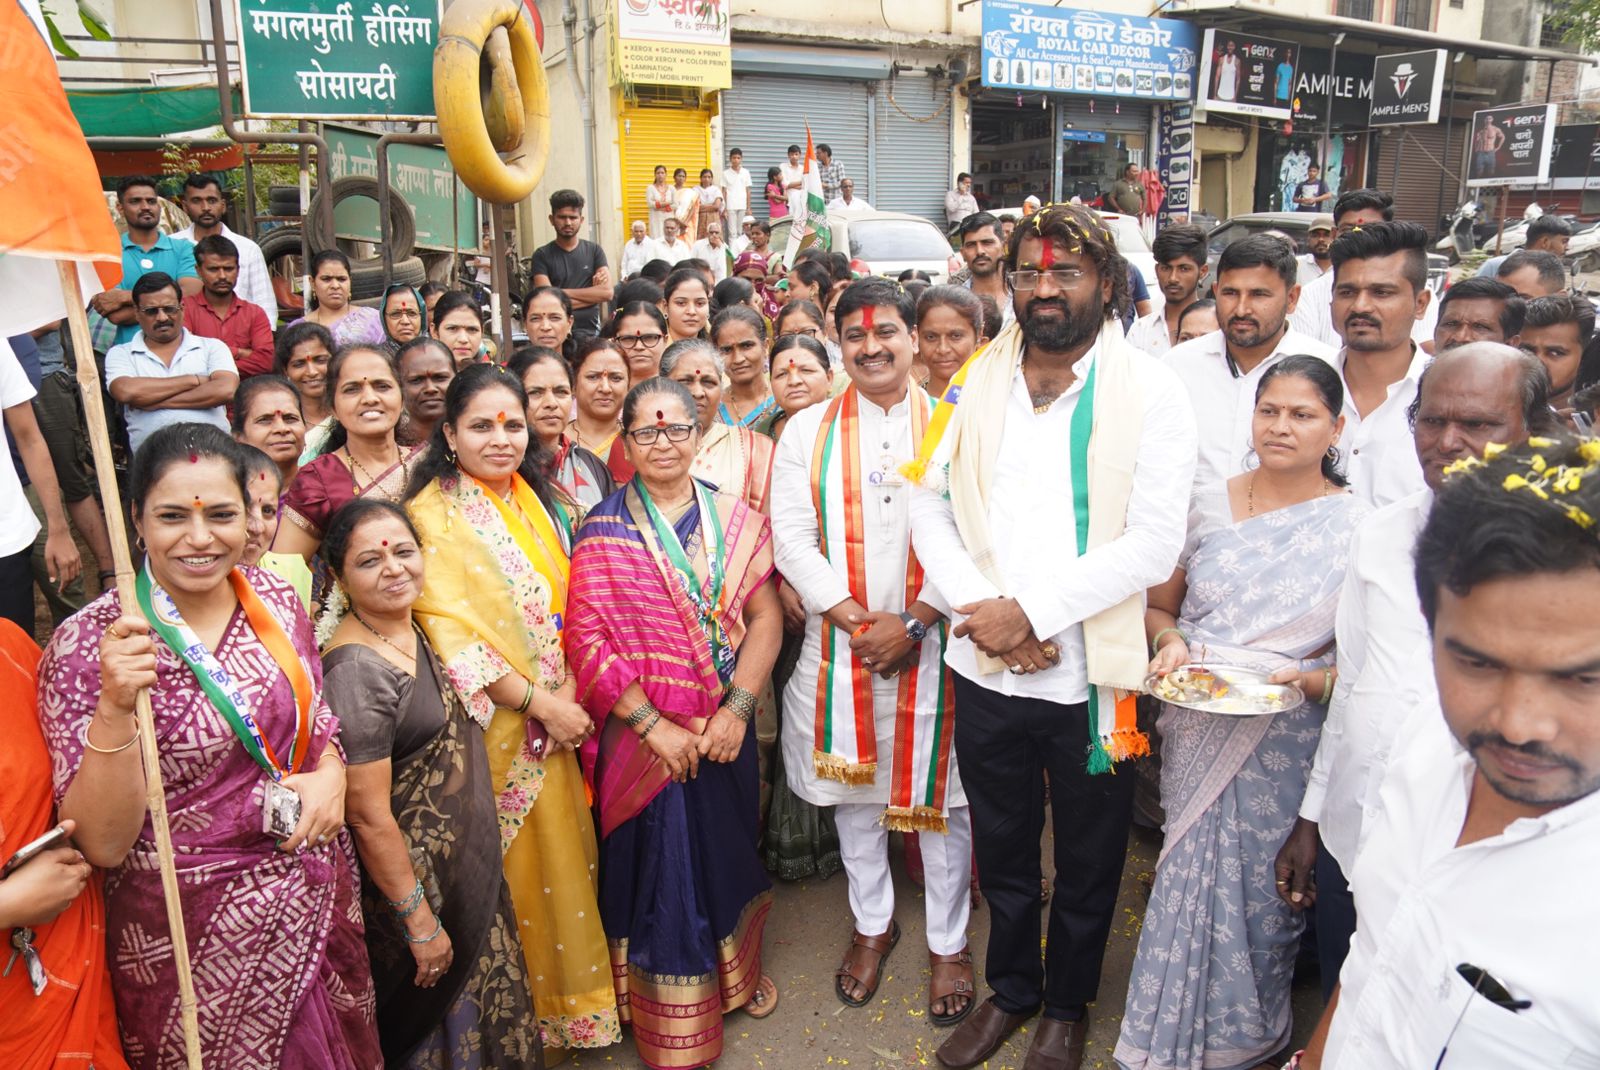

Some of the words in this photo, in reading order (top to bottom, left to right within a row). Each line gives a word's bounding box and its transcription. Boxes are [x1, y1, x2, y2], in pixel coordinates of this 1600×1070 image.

[362, 3, 432, 47] हौसिंग
[1009, 8, 1069, 38] रॉयल
[1073, 18, 1116, 43] कार
[1119, 18, 1172, 48] डेकोर
[661, 47, 696, 55] SCANNING
[1037, 36, 1080, 53] ROYAL
[1082, 41, 1109, 56] CAR
[1110, 45, 1151, 59] DECOR
[1015, 48, 1026, 58] All
[1027, 49, 1040, 59] Car
[1041, 50, 1081, 63] Accessories
[1082, 54, 1088, 63] &
[1089, 54, 1104, 65] Seat
[1105, 56, 1124, 67] Cover
[1125, 58, 1168, 72] Manufacturing
[296, 58, 397, 100] सोसायटी
[1359, 79, 1373, 100] M
[1372, 105, 1403, 117] AMPLE
[1404, 102, 1429, 114] MEN'S
